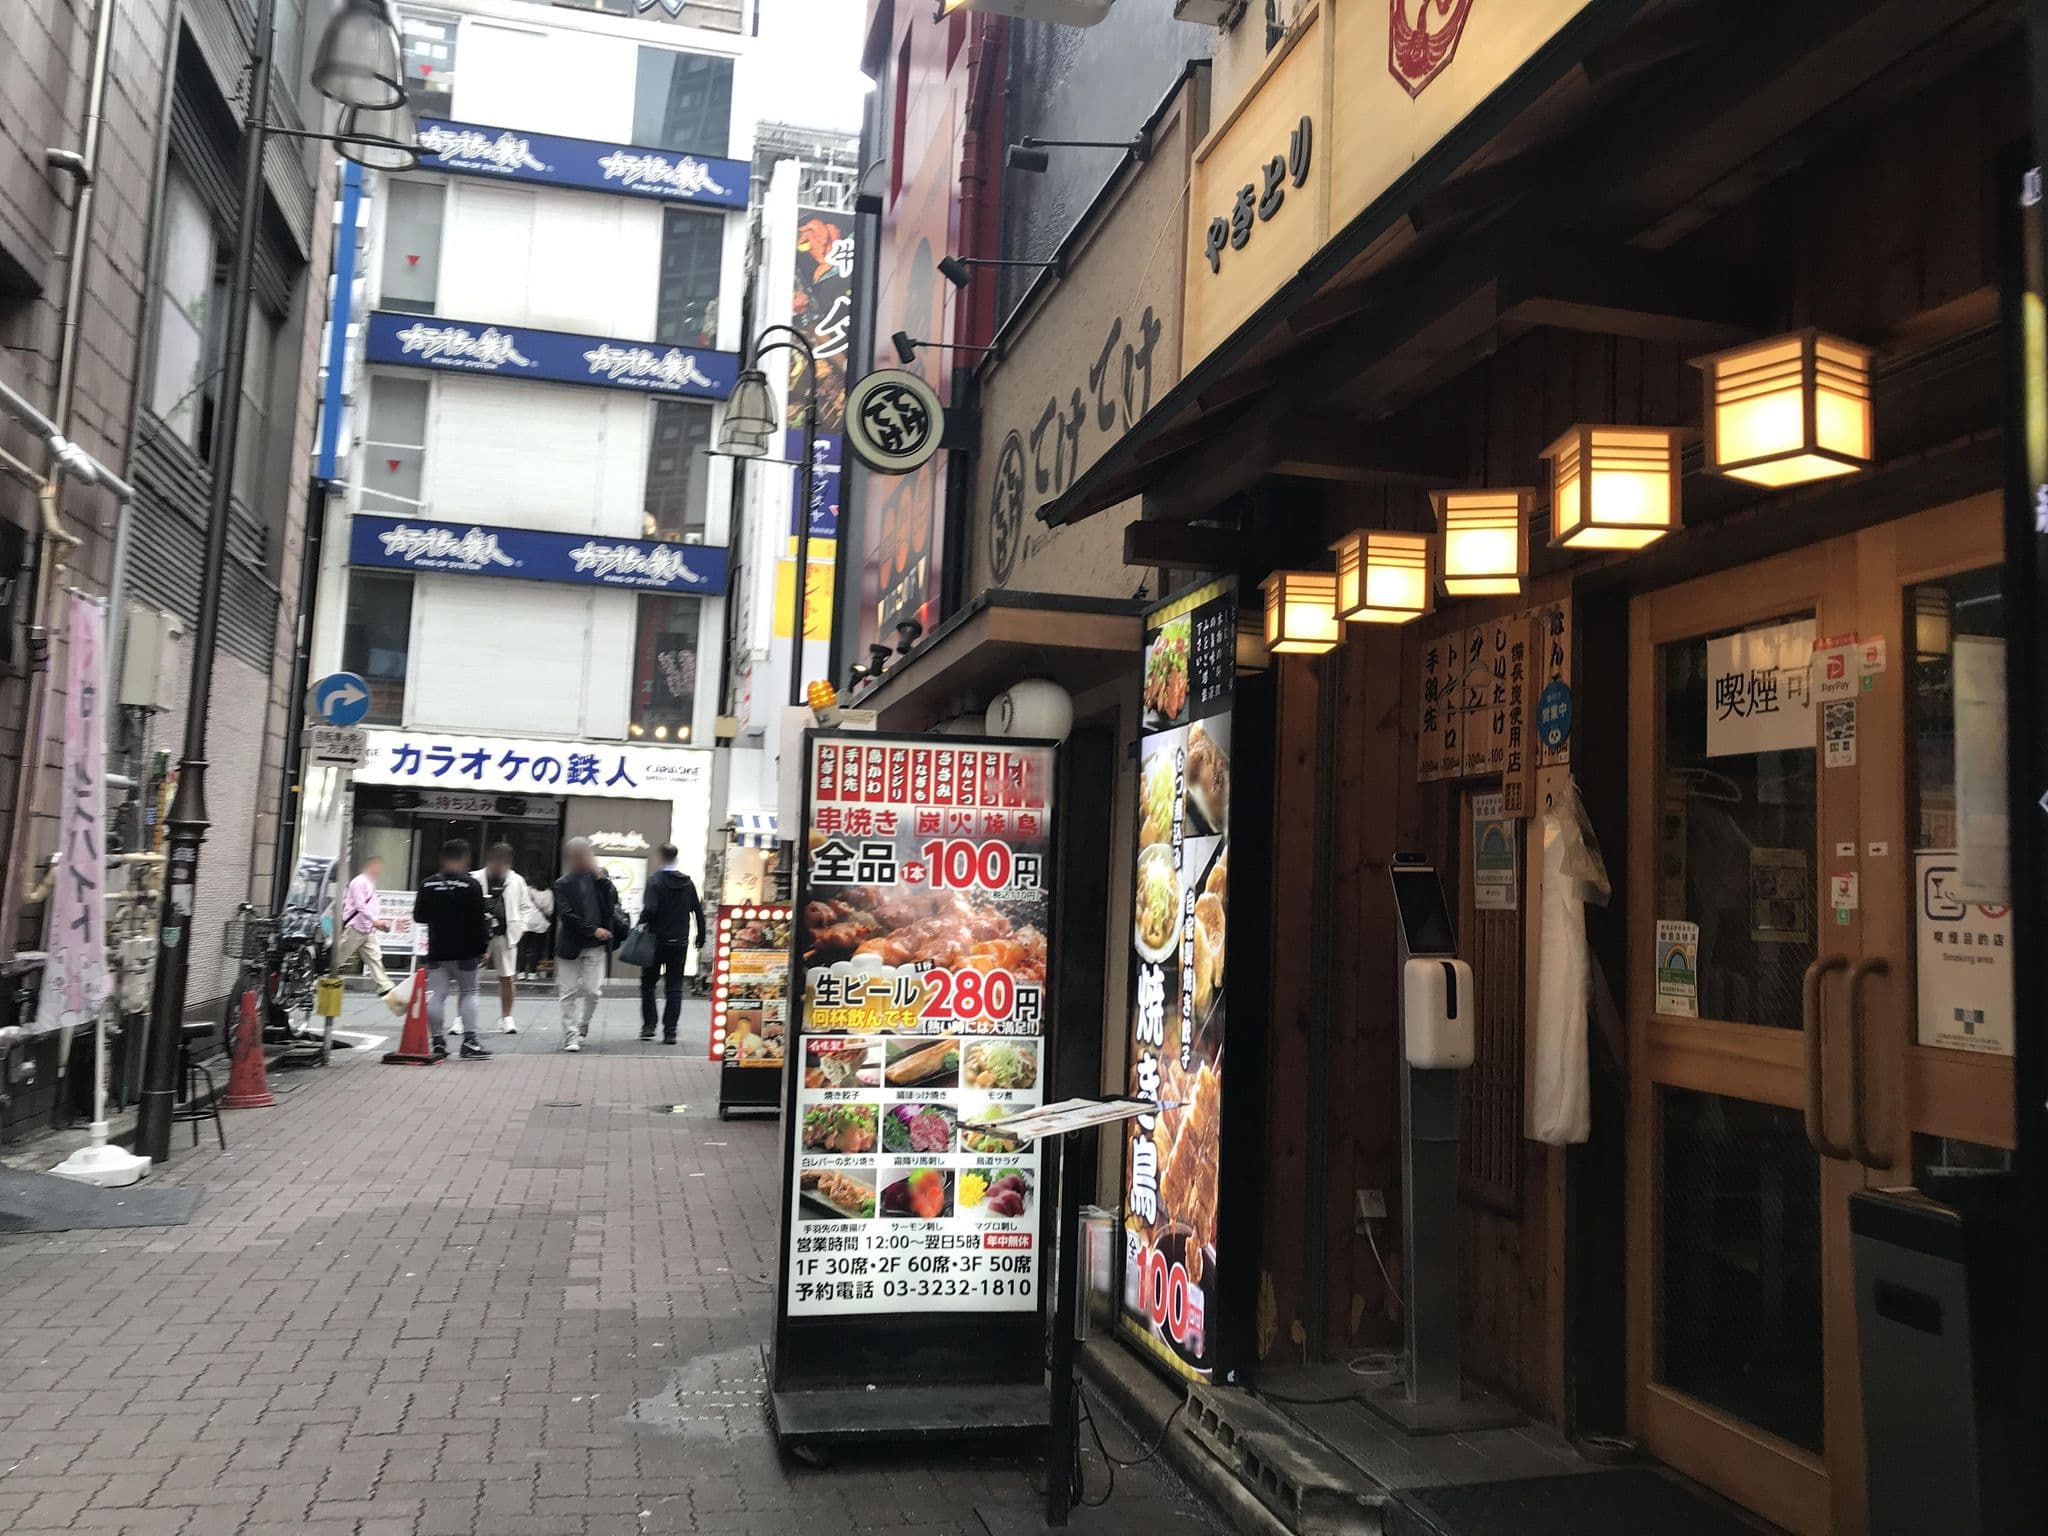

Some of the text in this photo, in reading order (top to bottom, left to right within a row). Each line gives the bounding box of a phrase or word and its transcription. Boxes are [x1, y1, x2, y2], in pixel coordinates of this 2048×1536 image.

[1205, 116, 1312, 274] やきとり
[1424, 648, 1439, 732] 手羽先
[1493, 628, 1506, 735] しいたけ
[1714, 665, 1812, 722] 喫煙可
[1822, 680, 1849, 692] PayPay
[1507, 641, 1524, 774] 備長炭使用店
[1542, 702, 1567, 723] 営業中
[389, 743, 638, 787] カラオケの鉄人
[820, 748, 836, 789] ねぎま
[843, 748, 858, 792] 手羽先
[915, 751, 927, 801] すなぎも
[937, 751, 952, 798] ささみ
[960, 752, 974, 804] なんこつ
[816, 807, 898, 836] 串焼き
[813, 841, 1039, 889] 全品 1本 100円
[1933, 931, 2004, 947] 喫煙目的店
[815, 970, 1039, 1020] 生ビール 280円
[811, 1009, 917, 1029] 何杯飲んでも
[824, 1091, 860, 1100] 焼き餃子
[987, 1091, 1013, 1100] モツ煮
[1131, 964, 1165, 1225] 焼き鳥
[797, 1237, 859, 1252] 営業時間
[986, 1235, 1030, 1247] 年中無休
[803, 1224, 867, 1233] 手羽先の唐揚げ
[891, 1223, 944, 1232] サーモン刺し
[975, 1222, 1018, 1231] マグロ刺し
[797, 1259, 818, 1275] 1F
[990, 1255, 1031, 1273] 50席
[795, 1279, 1031, 1301] 予約電話 03-3232-1810
